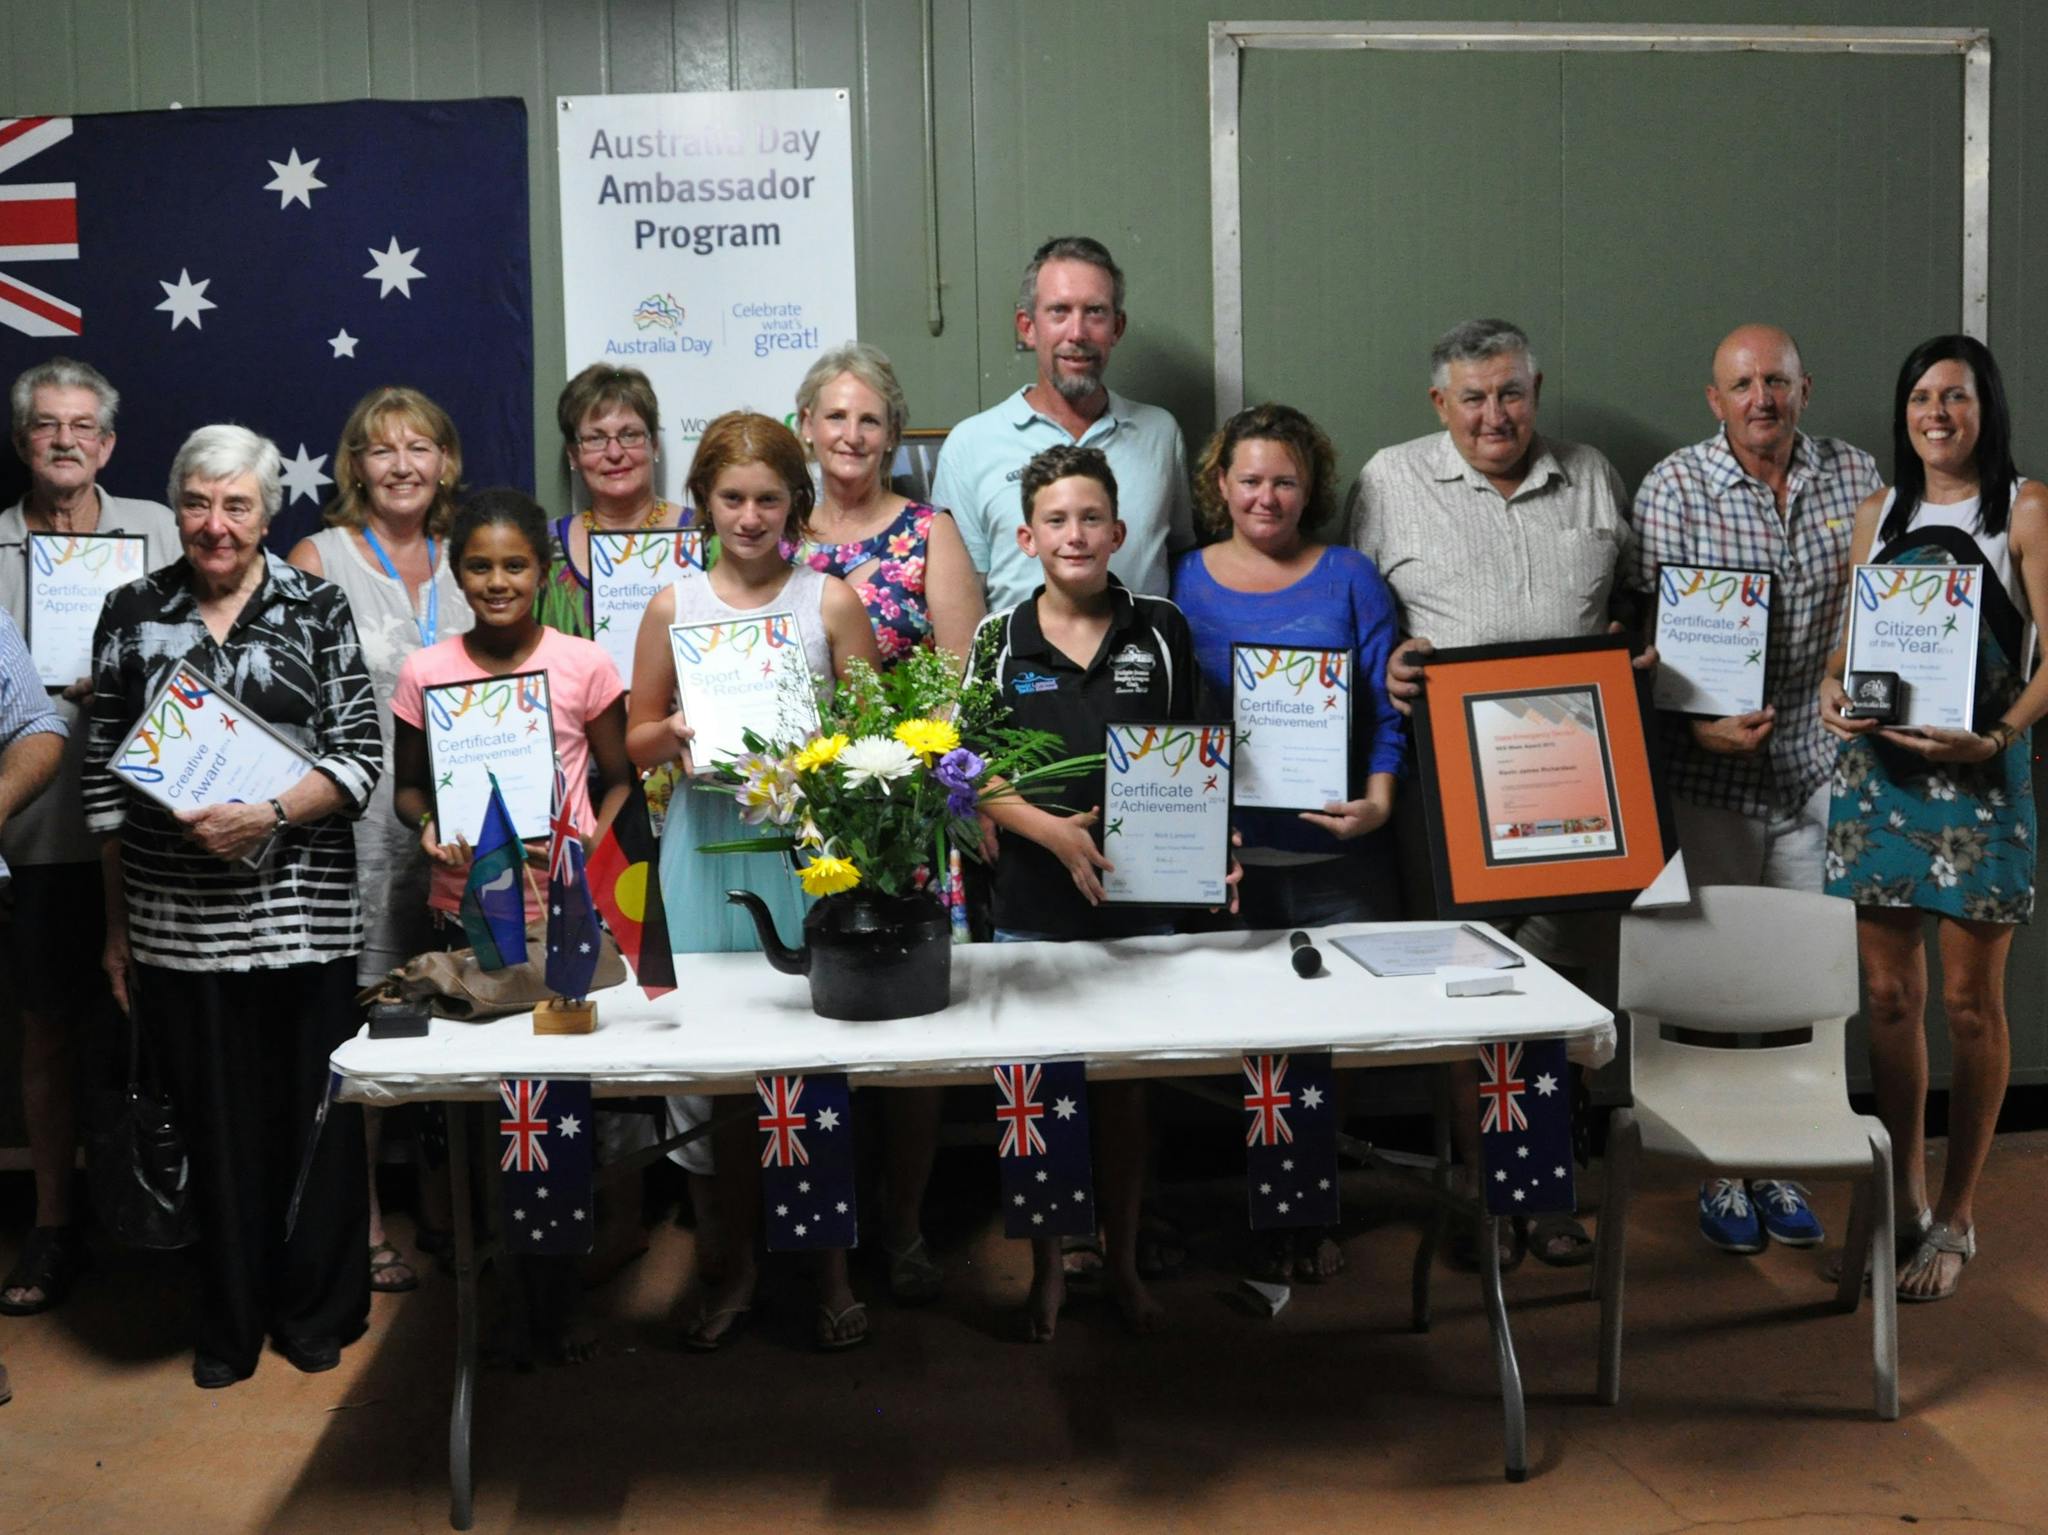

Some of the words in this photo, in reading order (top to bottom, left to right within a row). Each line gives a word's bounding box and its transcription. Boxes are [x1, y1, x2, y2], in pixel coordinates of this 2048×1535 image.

[589, 124, 745, 160] Australia
[757, 124, 820, 161] Day
[598, 168, 816, 205] Ambassador
[634, 219, 781, 256] Program
[732, 303, 801, 318] Celebrate
[605, 336, 676, 354] Australia
[681, 336, 713, 357] Day
[754, 327, 818, 357] great!
[1661, 612, 1736, 631] Certificate
[1874, 620, 1938, 637] Citizen
[1668, 628, 1760, 647] Appreciation
[1868, 639, 1879, 648] of
[1880, 639, 1896, 648] the
[1897, 637, 1939, 654] Year
[690, 668, 741, 687] Sport
[1240, 698, 1315, 715] Certificate
[1248, 713, 1329, 729] Achievement
[436, 731, 518, 753] Certificate
[447, 744, 533, 765] Achievement
[167, 743, 209, 799] Creative
[190, 752, 227, 803] Award
[1111, 782, 1194, 798] Certificate
[1119, 800, 1208, 813] Achievement
